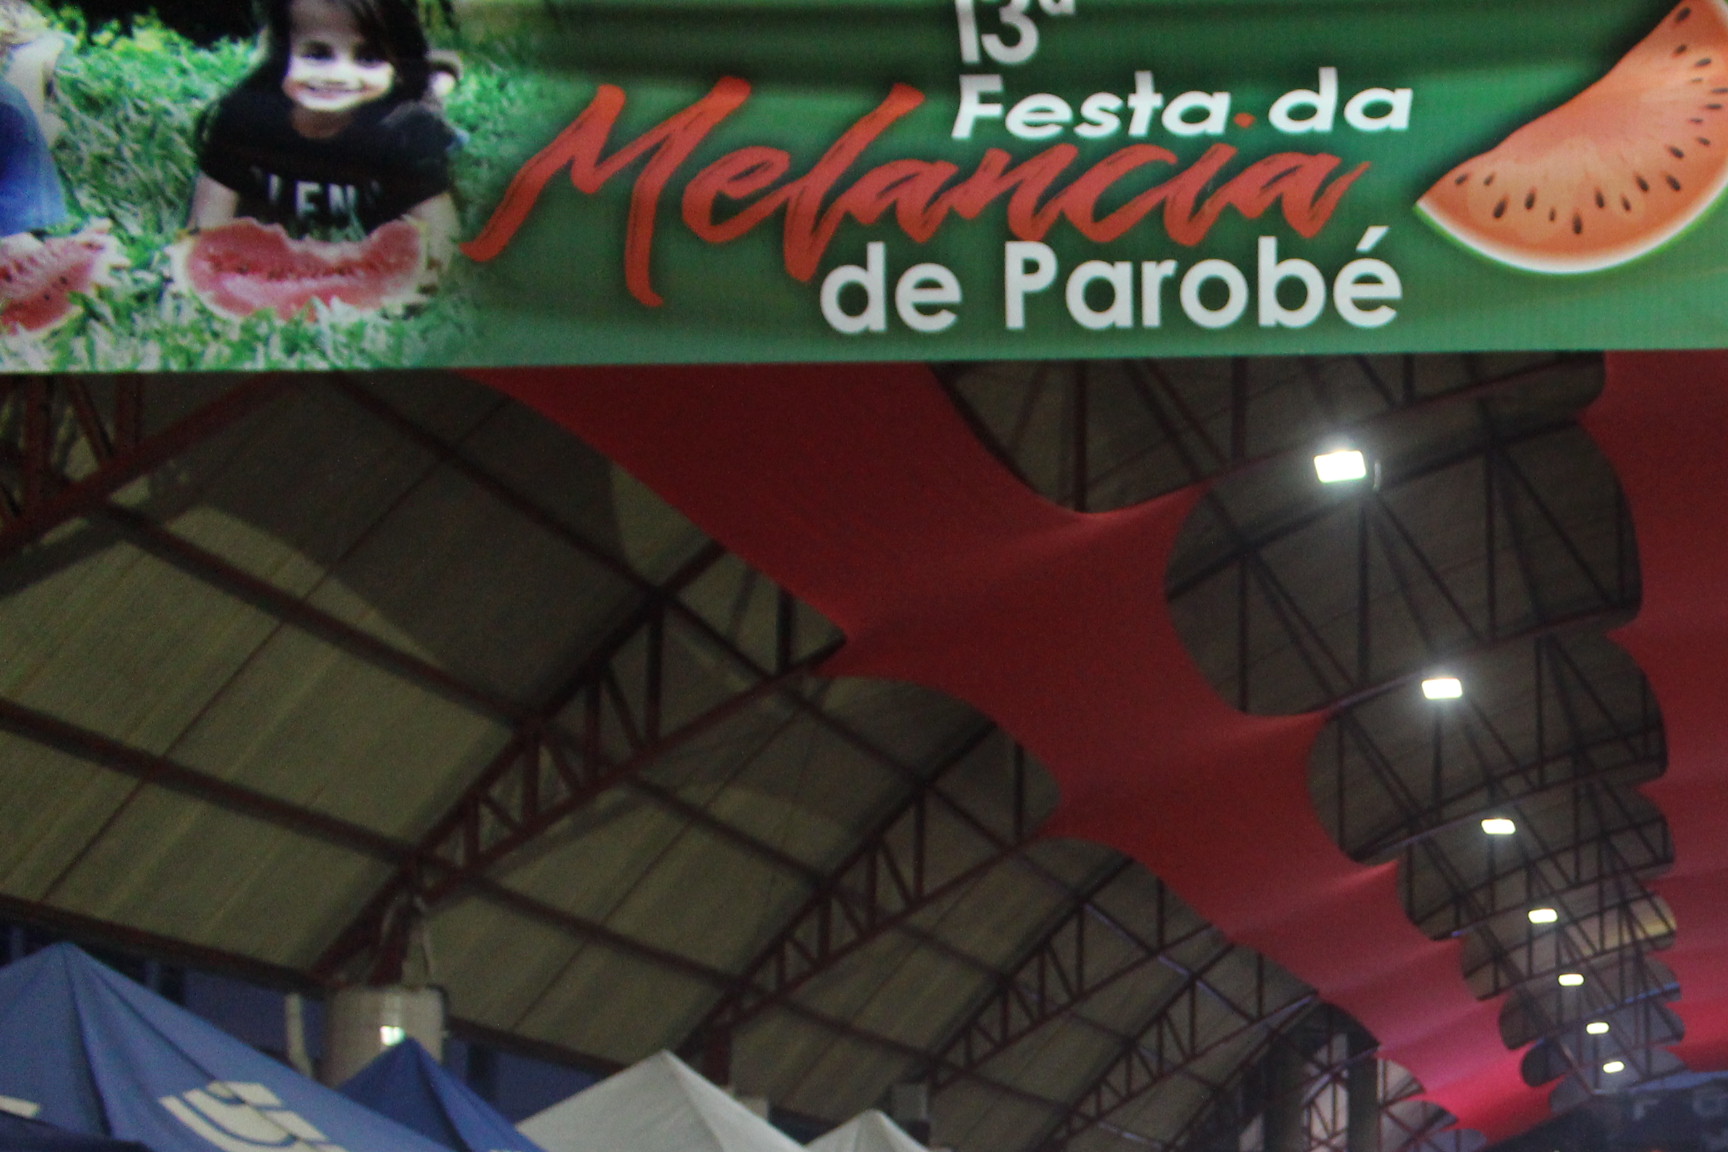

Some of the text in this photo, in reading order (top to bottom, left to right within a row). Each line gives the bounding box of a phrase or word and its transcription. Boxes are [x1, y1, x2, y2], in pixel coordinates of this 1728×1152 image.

[951, 67, 1414, 140] Festa da
[460, 76, 1372, 308] Melancia
[819, 226, 1403, 334] de Parobé
